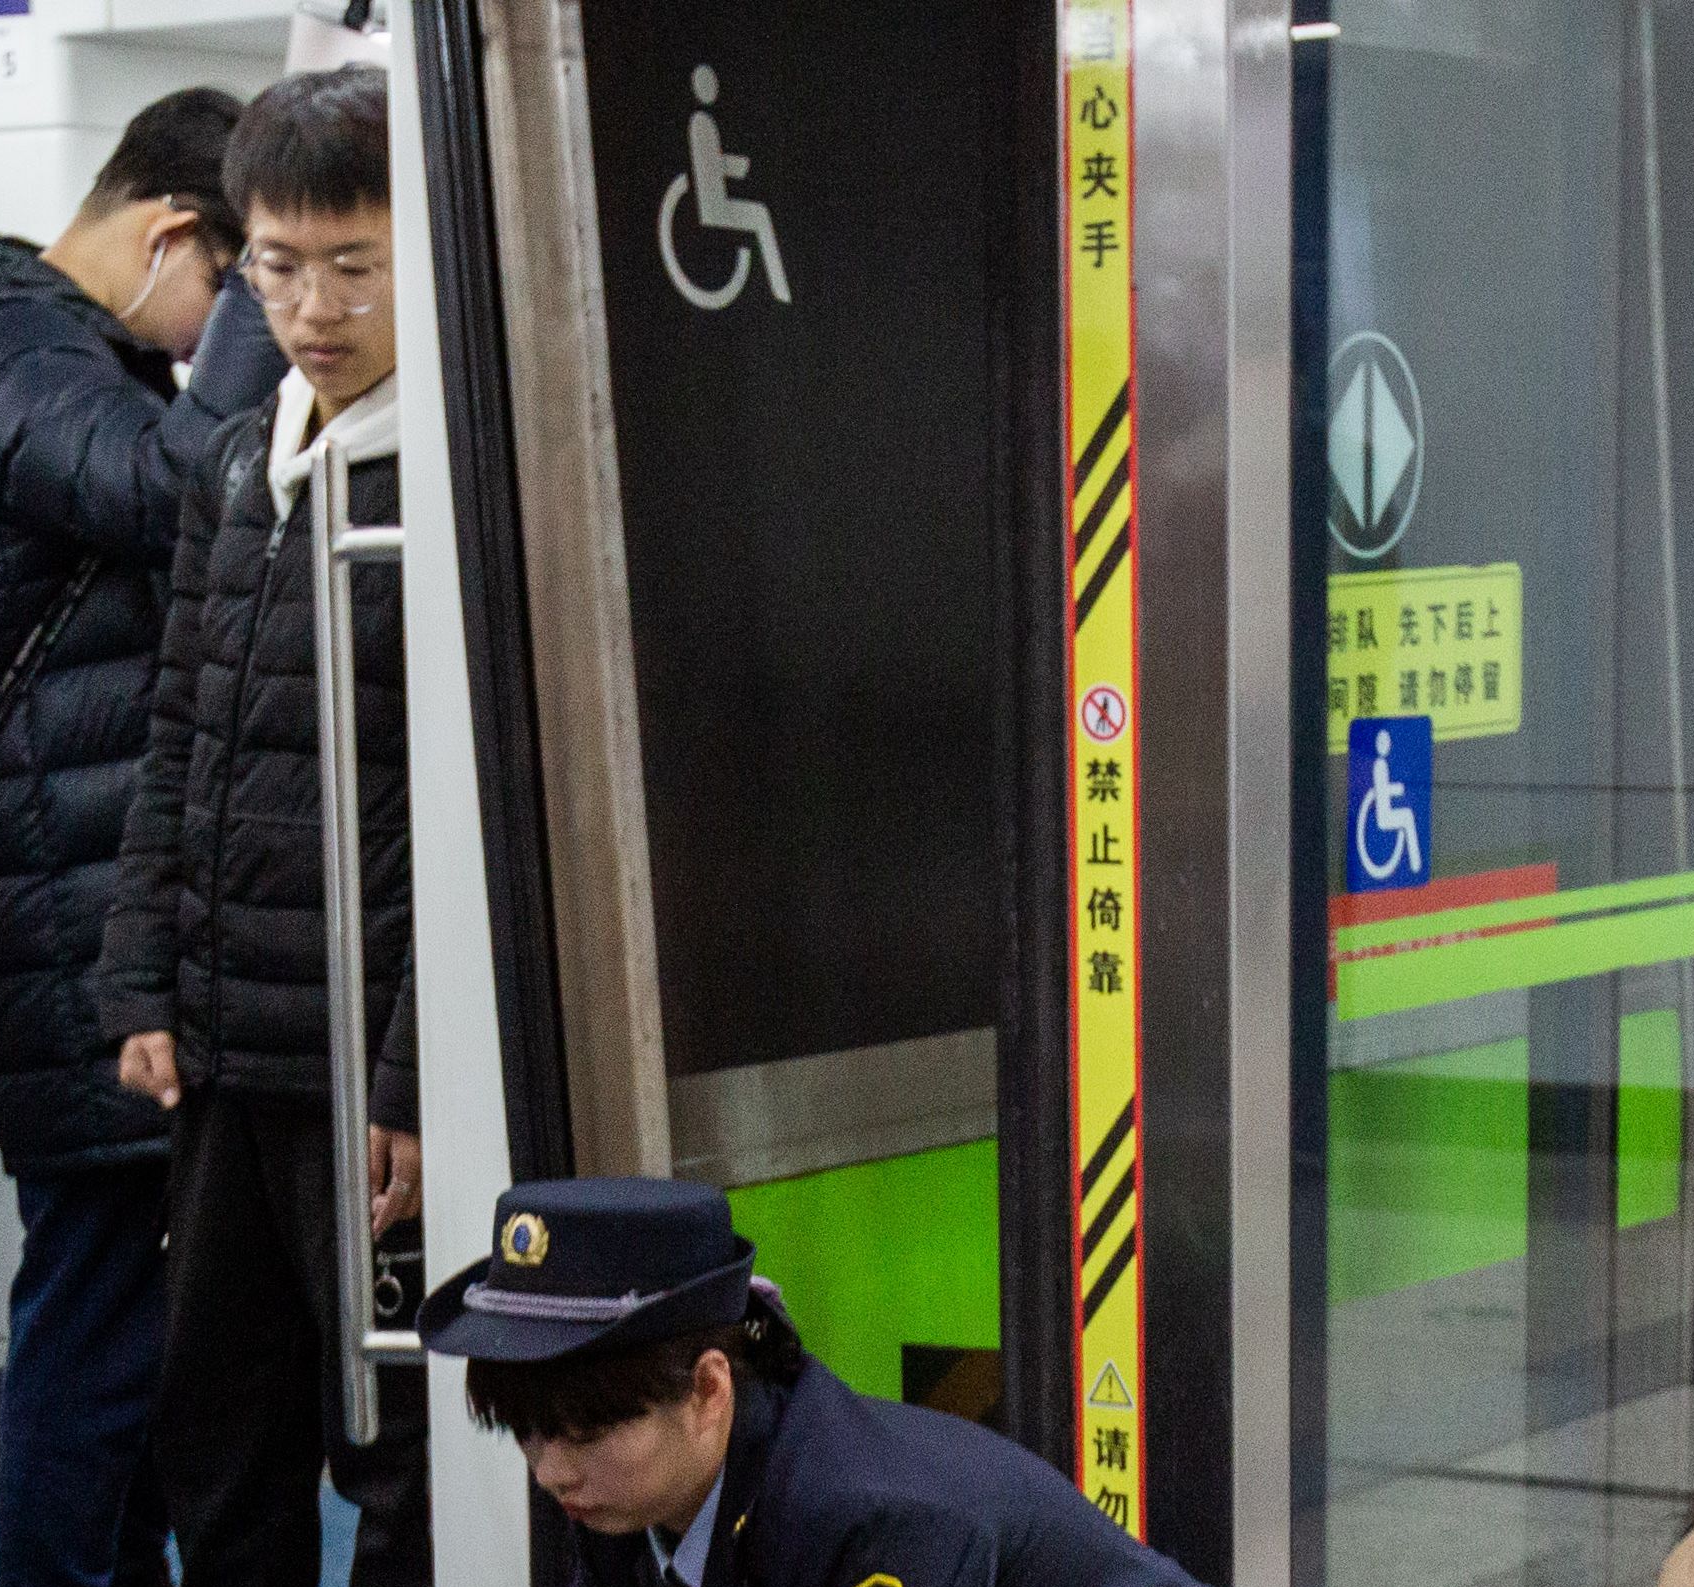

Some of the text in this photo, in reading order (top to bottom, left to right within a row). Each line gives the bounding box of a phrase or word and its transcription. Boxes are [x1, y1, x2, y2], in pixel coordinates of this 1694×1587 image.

[1400, 598, 1502, 647] 先下后上
[1399, 660, 1500, 709] 请勿停留
[1087, 758, 1123, 994] 禁止倚靠
